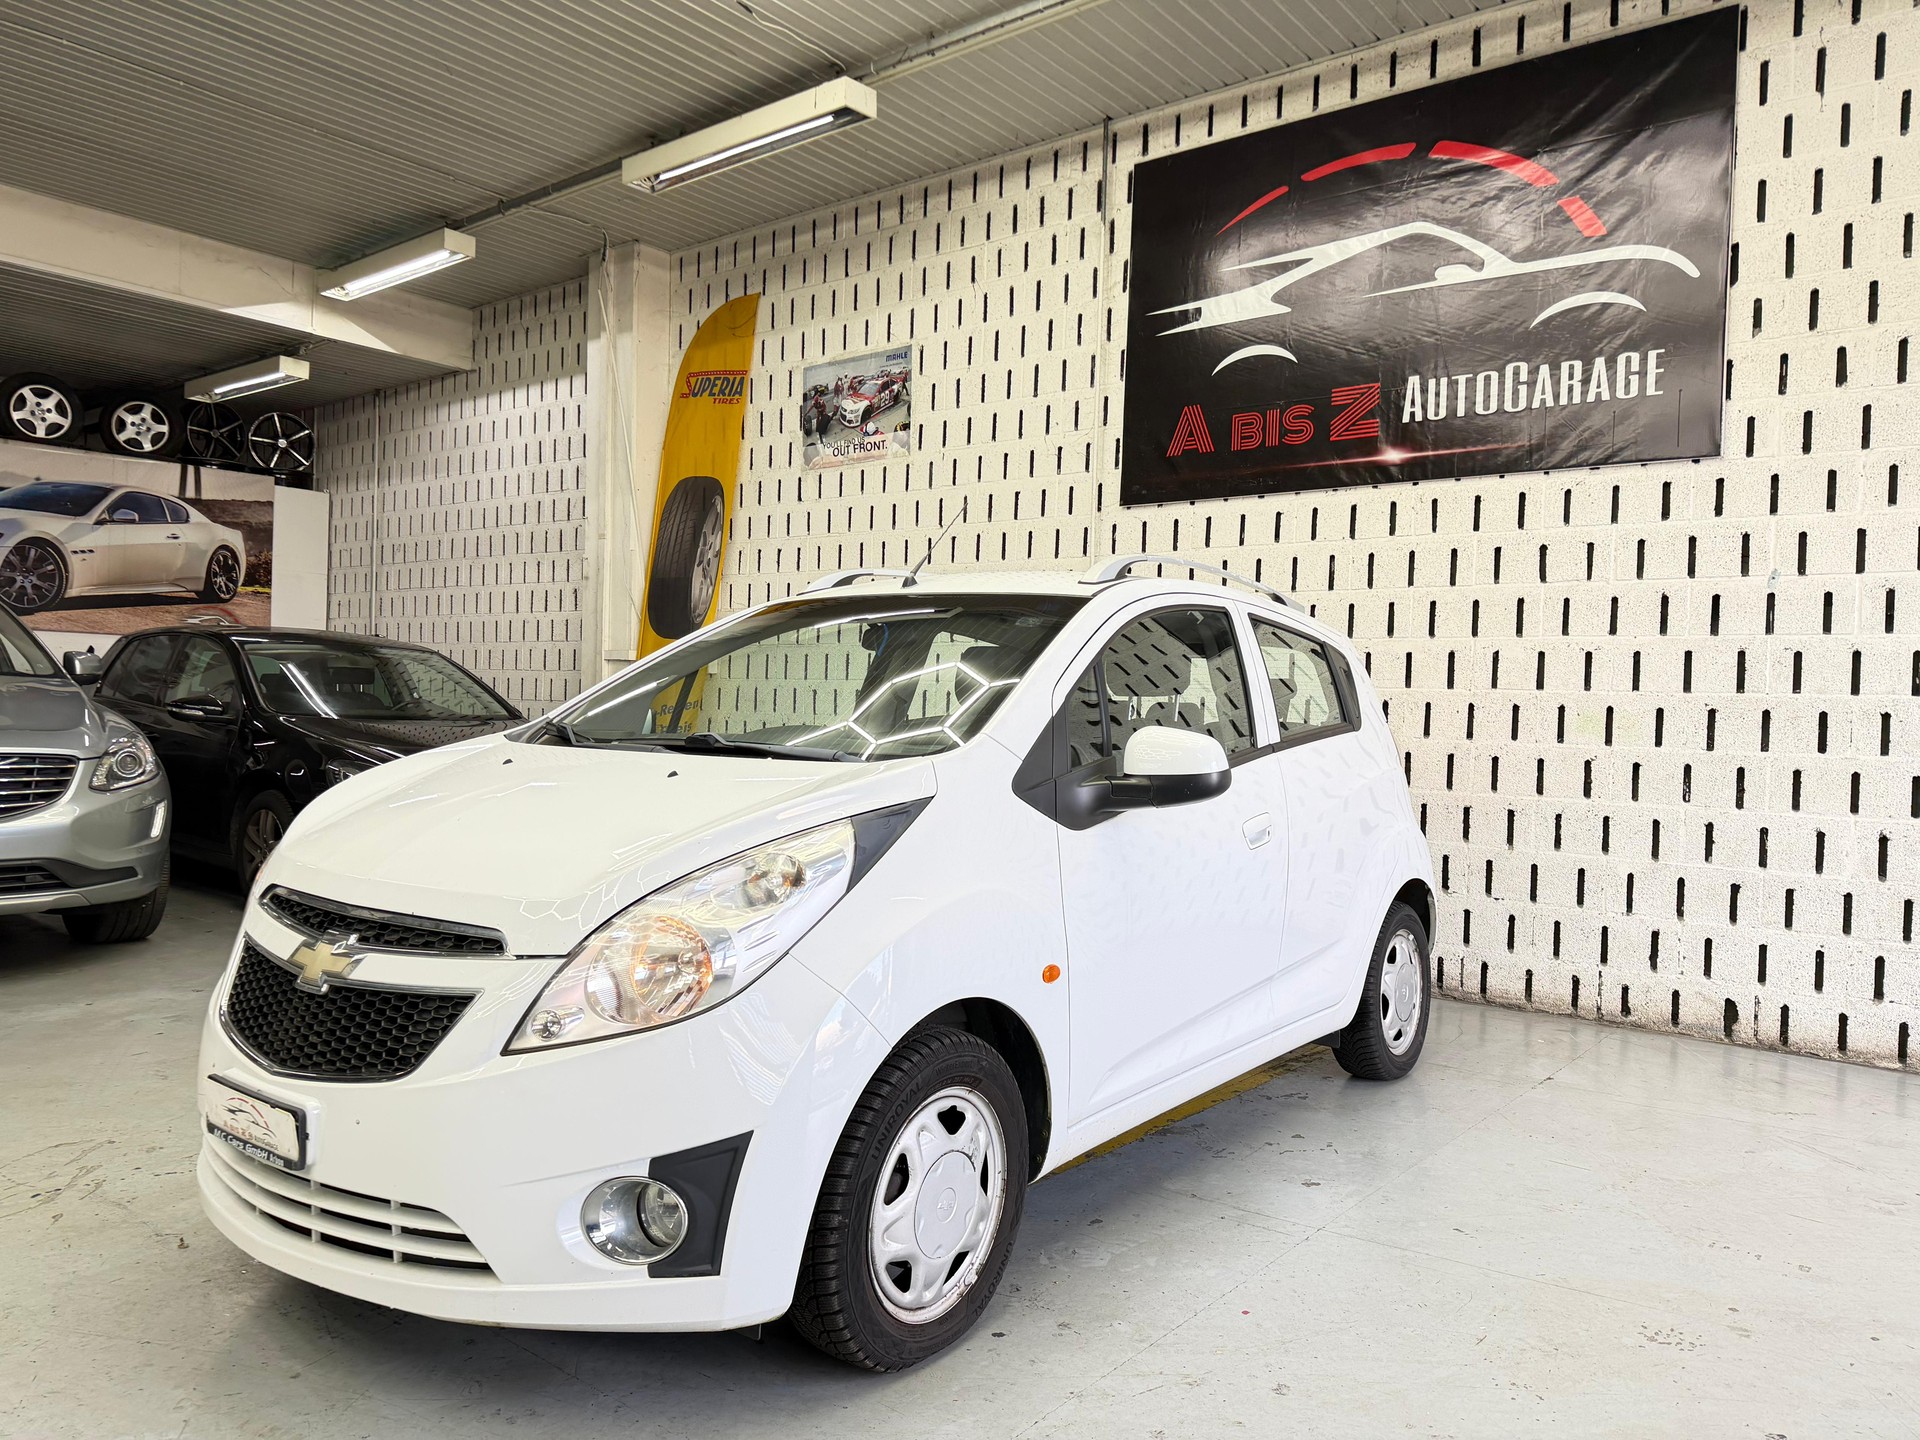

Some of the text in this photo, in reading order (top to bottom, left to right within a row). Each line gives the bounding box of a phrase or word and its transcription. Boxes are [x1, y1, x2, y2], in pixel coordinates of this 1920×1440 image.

[885, 351, 908, 362] MAHLE
[680, 370, 748, 398] SUPERIA
[712, 397, 741, 405] TIRES
[1166, 403, 1215, 457] A
[1231, 404, 1315, 452] BIS
[1329, 382, 1381, 441] Z
[832, 439, 888, 457] OUT FRONT.
[857, 436, 866, 444] US
[871, 1081, 922, 1160] UNIROYAL
[227, 1135, 244, 1149] Cars
[245, 1143, 268, 1160] GmbH
[972, 1240, 1013, 1317] UNIROYAL
